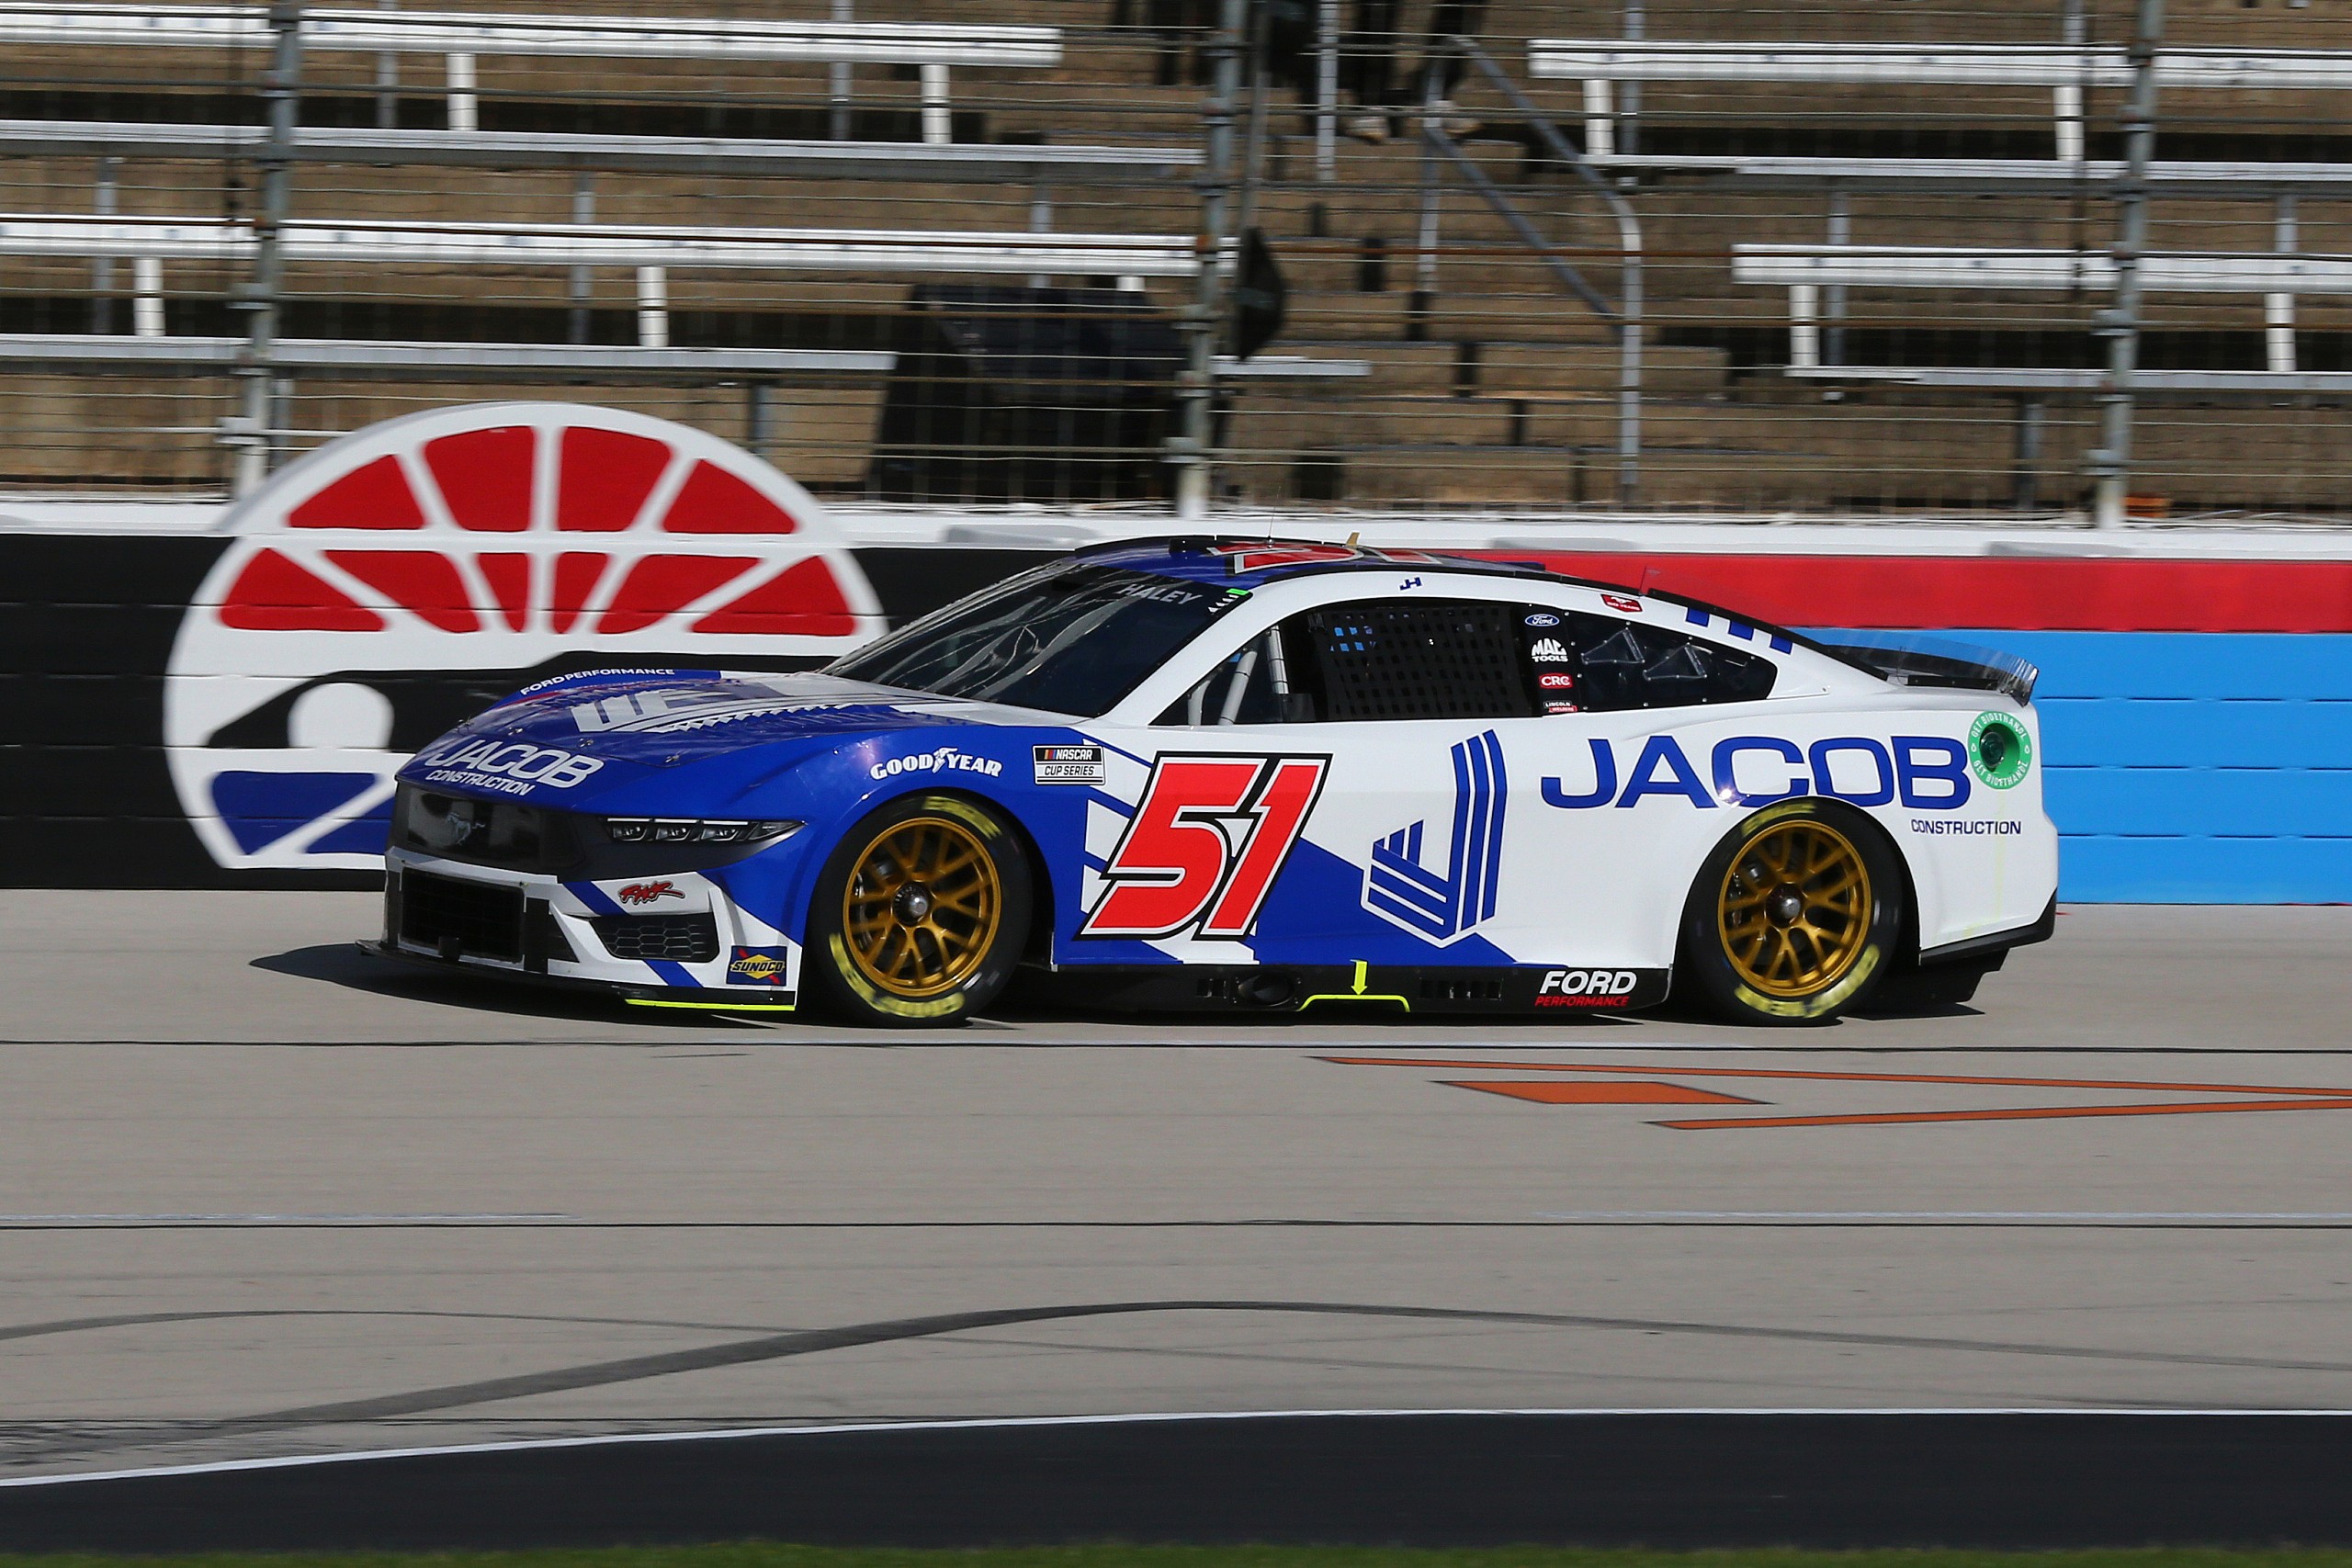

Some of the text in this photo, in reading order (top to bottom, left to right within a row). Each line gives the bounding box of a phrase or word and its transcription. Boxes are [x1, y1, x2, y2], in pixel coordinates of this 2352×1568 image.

[1115, 583, 1203, 604] HALEY
[1530, 615, 1555, 626] Ford
[1532, 637, 1567, 656] MAC
[520, 668, 675, 695] FORD PERFORMANCE
[1541, 676, 1571, 685] CRC
[1971, 712, 2027, 741] GET BIOETHANOL
[424, 739, 605, 788] JACOB
[1054, 749, 1093, 761] NASCAR
[1045, 765, 1094, 776] CUP SERIES
[1541, 736, 1972, 809] JACOB
[1973, 760, 2029, 786] GET BIOETHANOL
[425, 769, 536, 795] CONSTRUCTION
[1911, 819, 2021, 835] CONSTRUCTION
[1073, 751, 1332, 940] 51
[732, 961, 784, 973] SUNOCO
[1539, 970, 1637, 995] FORD
[1534, 996, 1630, 1007] PERFORMANCE
